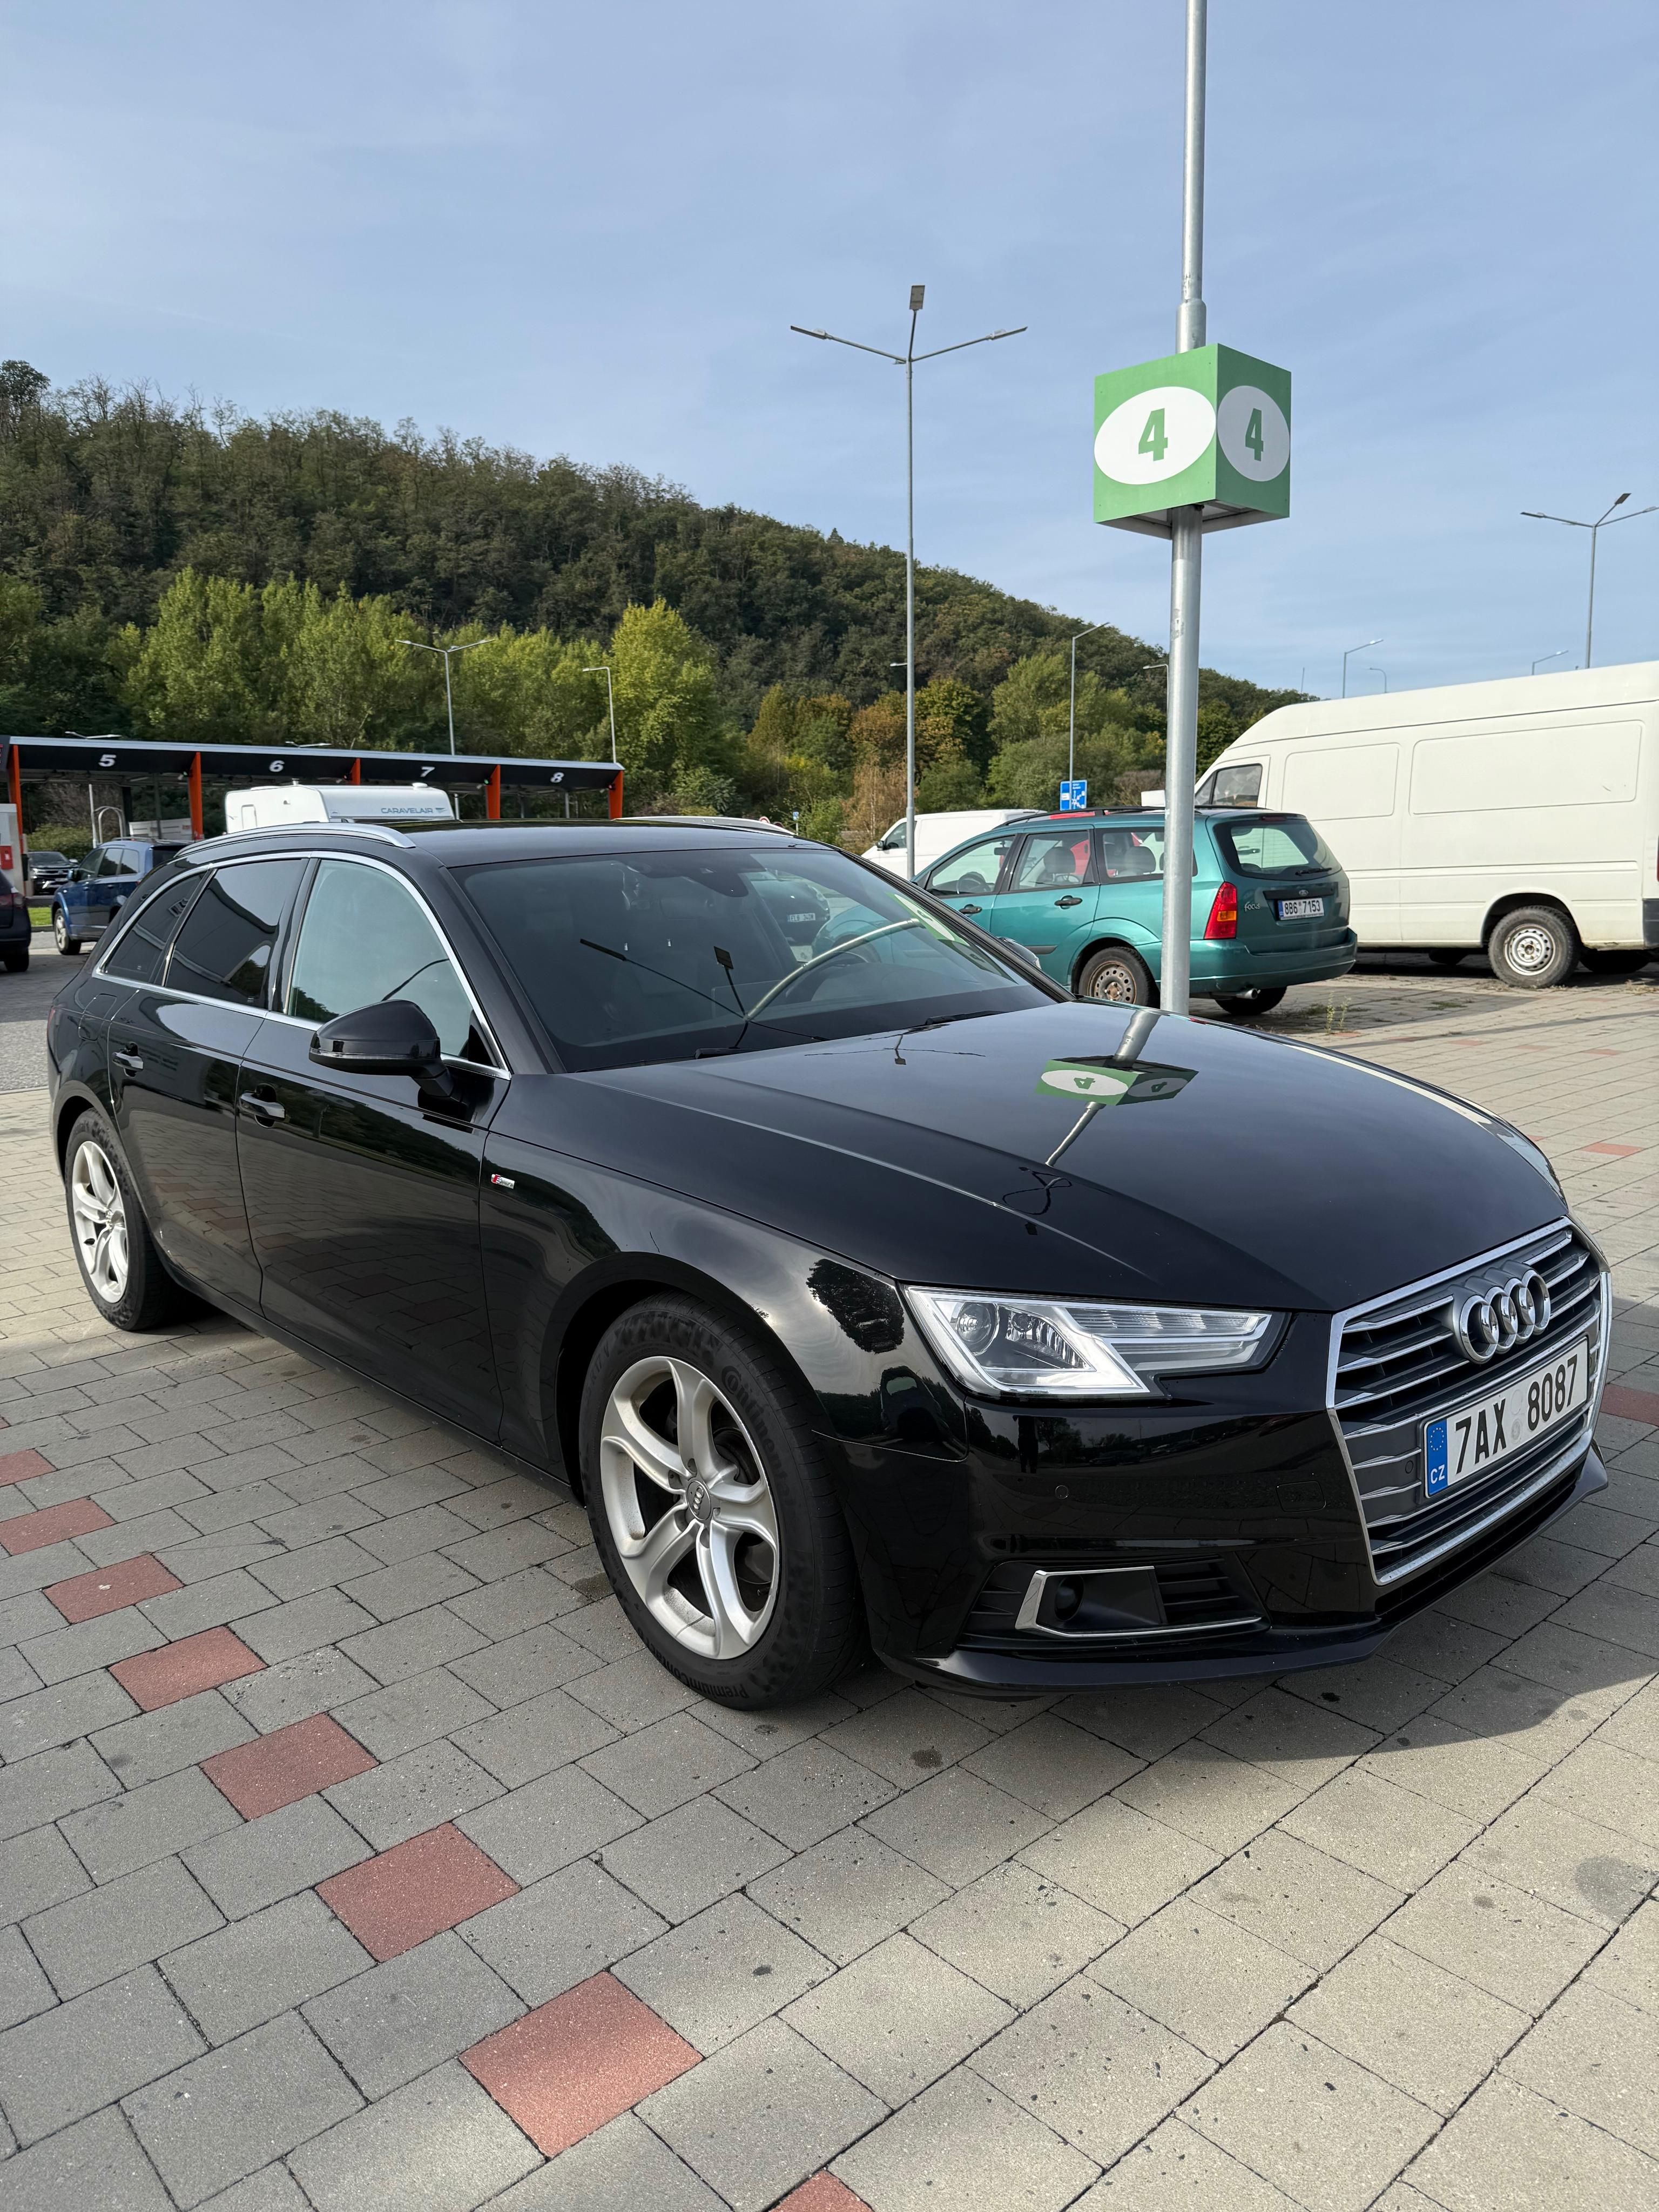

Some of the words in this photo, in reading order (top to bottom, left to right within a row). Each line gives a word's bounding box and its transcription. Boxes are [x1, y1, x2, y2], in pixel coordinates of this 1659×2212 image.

[1138, 408, 1168, 462] 4
[1245, 408, 1264, 462] 4
[98, 754, 116, 767] 5
[269, 760, 285, 772] 6
[420, 766, 435, 778] 7
[550, 772, 564, 783] 8
[1284, 902, 1298, 915] 8B6
[1303, 900, 1320, 913] 7153
[1455, 1398, 1507, 1474] 7AX
[1528, 1354, 1577, 1431] 8087
[1431, 1464, 1445, 1484] CZ
